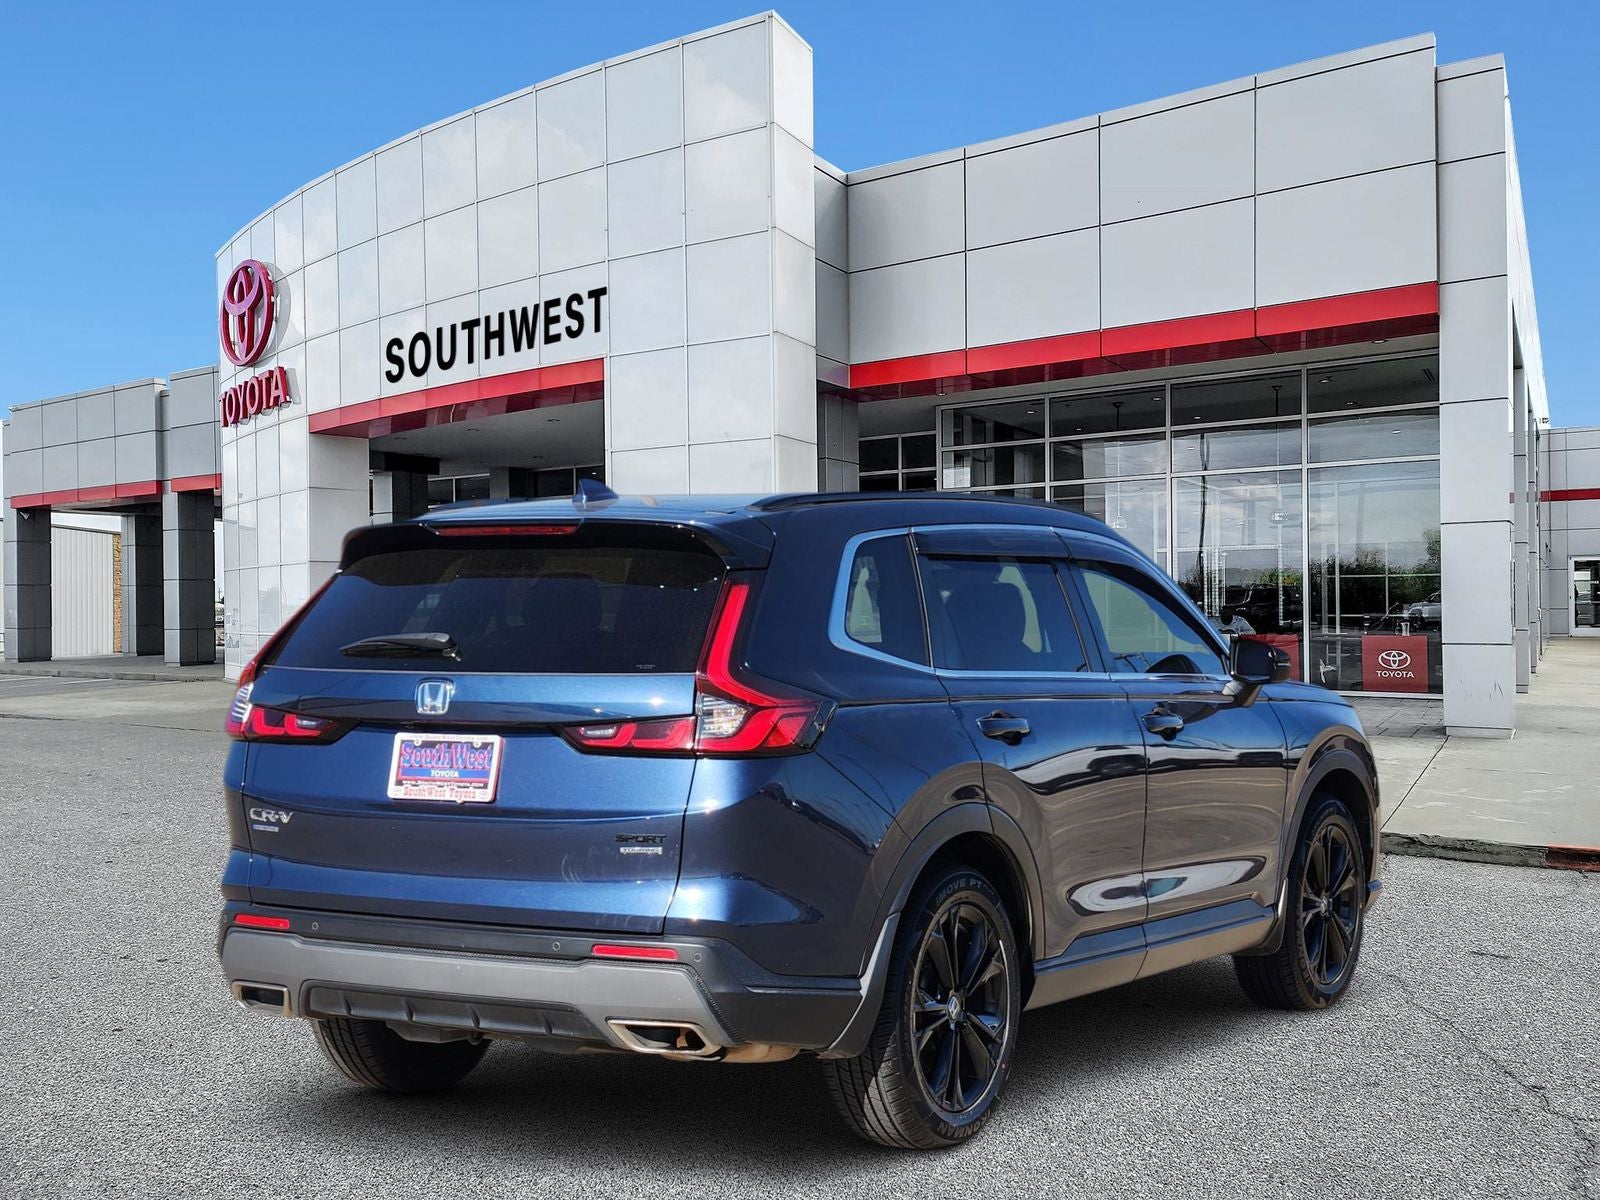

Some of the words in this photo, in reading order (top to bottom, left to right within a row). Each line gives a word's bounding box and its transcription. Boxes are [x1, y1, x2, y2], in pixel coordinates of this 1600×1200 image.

[385, 286, 607, 383] SOUTHWEST
[218, 366, 291, 427] TOYOTA
[1375, 670, 1415, 678] TOYOTA
[250, 808, 294, 824] CR-V
[615, 834, 667, 843] SPORT
